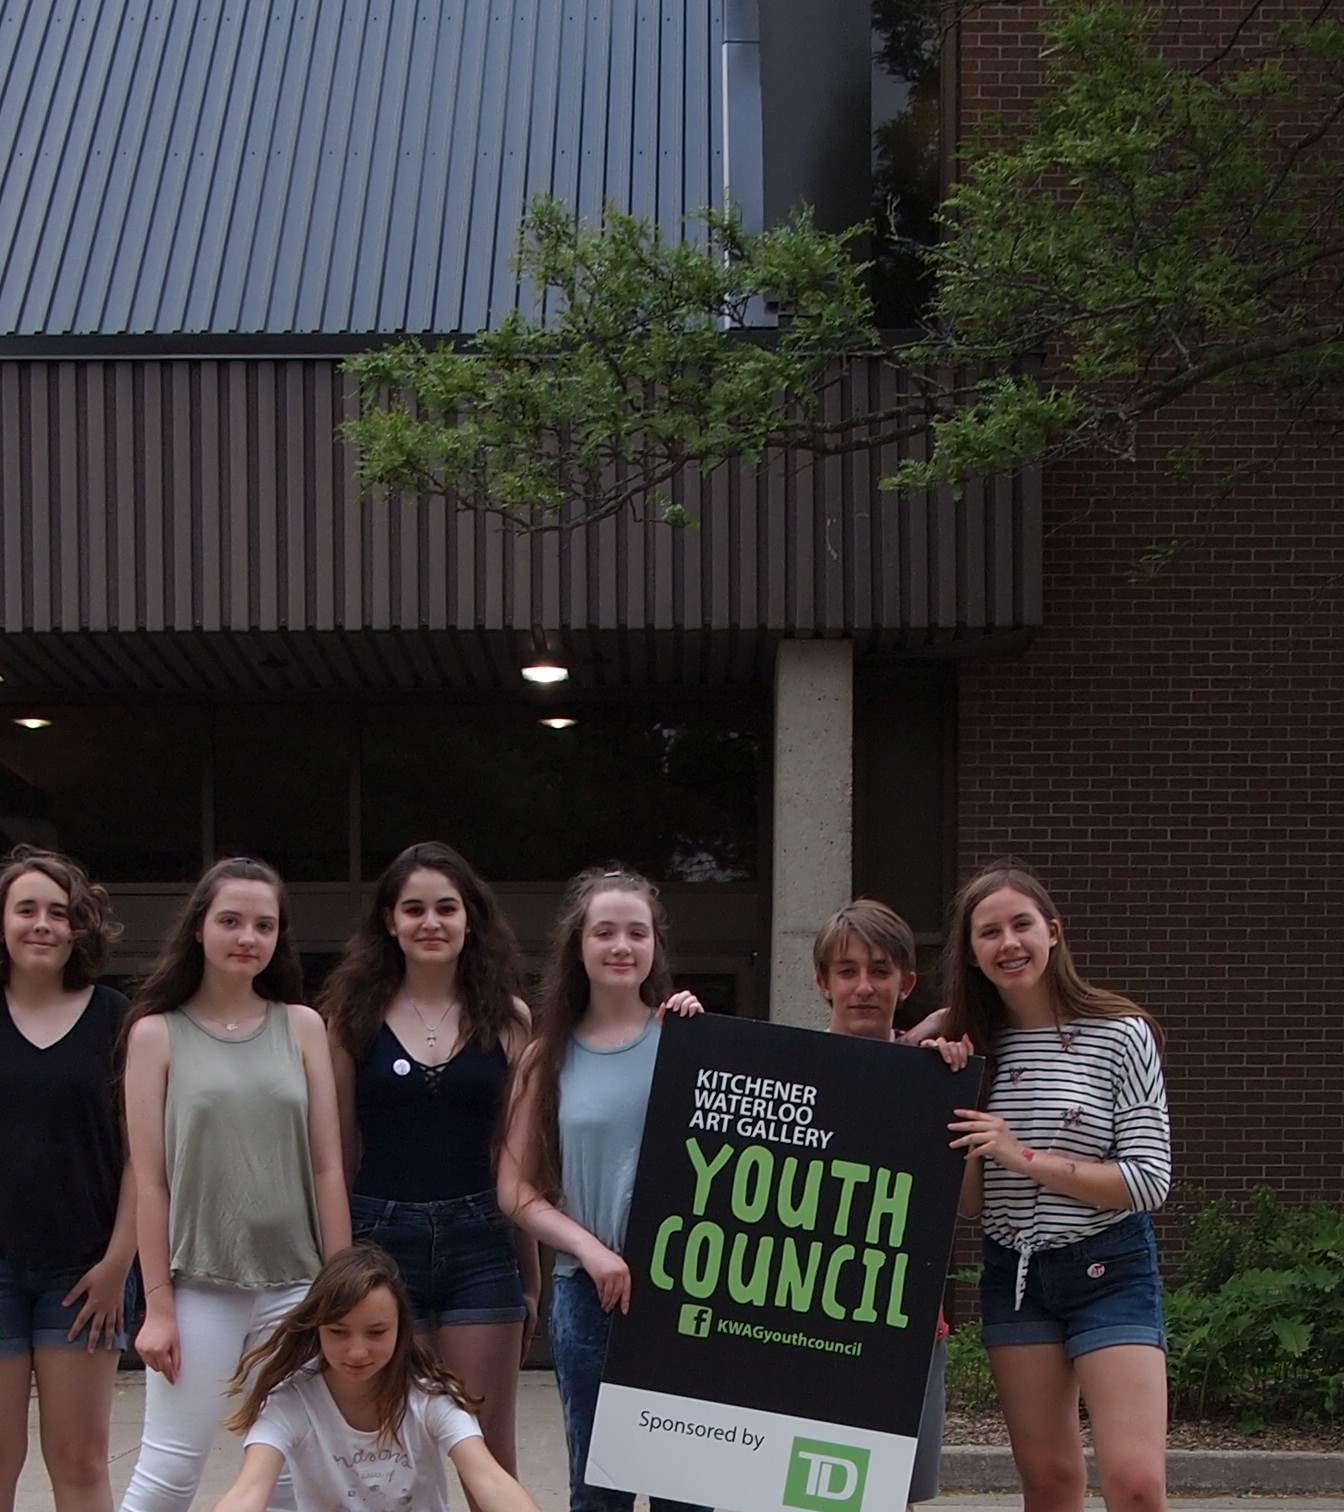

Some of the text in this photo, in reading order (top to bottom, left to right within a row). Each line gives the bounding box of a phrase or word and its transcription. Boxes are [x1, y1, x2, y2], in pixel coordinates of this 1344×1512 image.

[696, 1068, 818, 1106] KITCHENER
[694, 1089, 813, 1126] WATERLOO
[688, 1110, 834, 1150] ART GALLERY
[685, 1137, 913, 1248] YOUTH
[650, 1215, 910, 1329] COUNCIL
[716, 1319, 863, 1357] KWAGyouthcouncil
[638, 1410, 765, 1451] Sponsored by
[798, 1450, 859, 1502] TD
